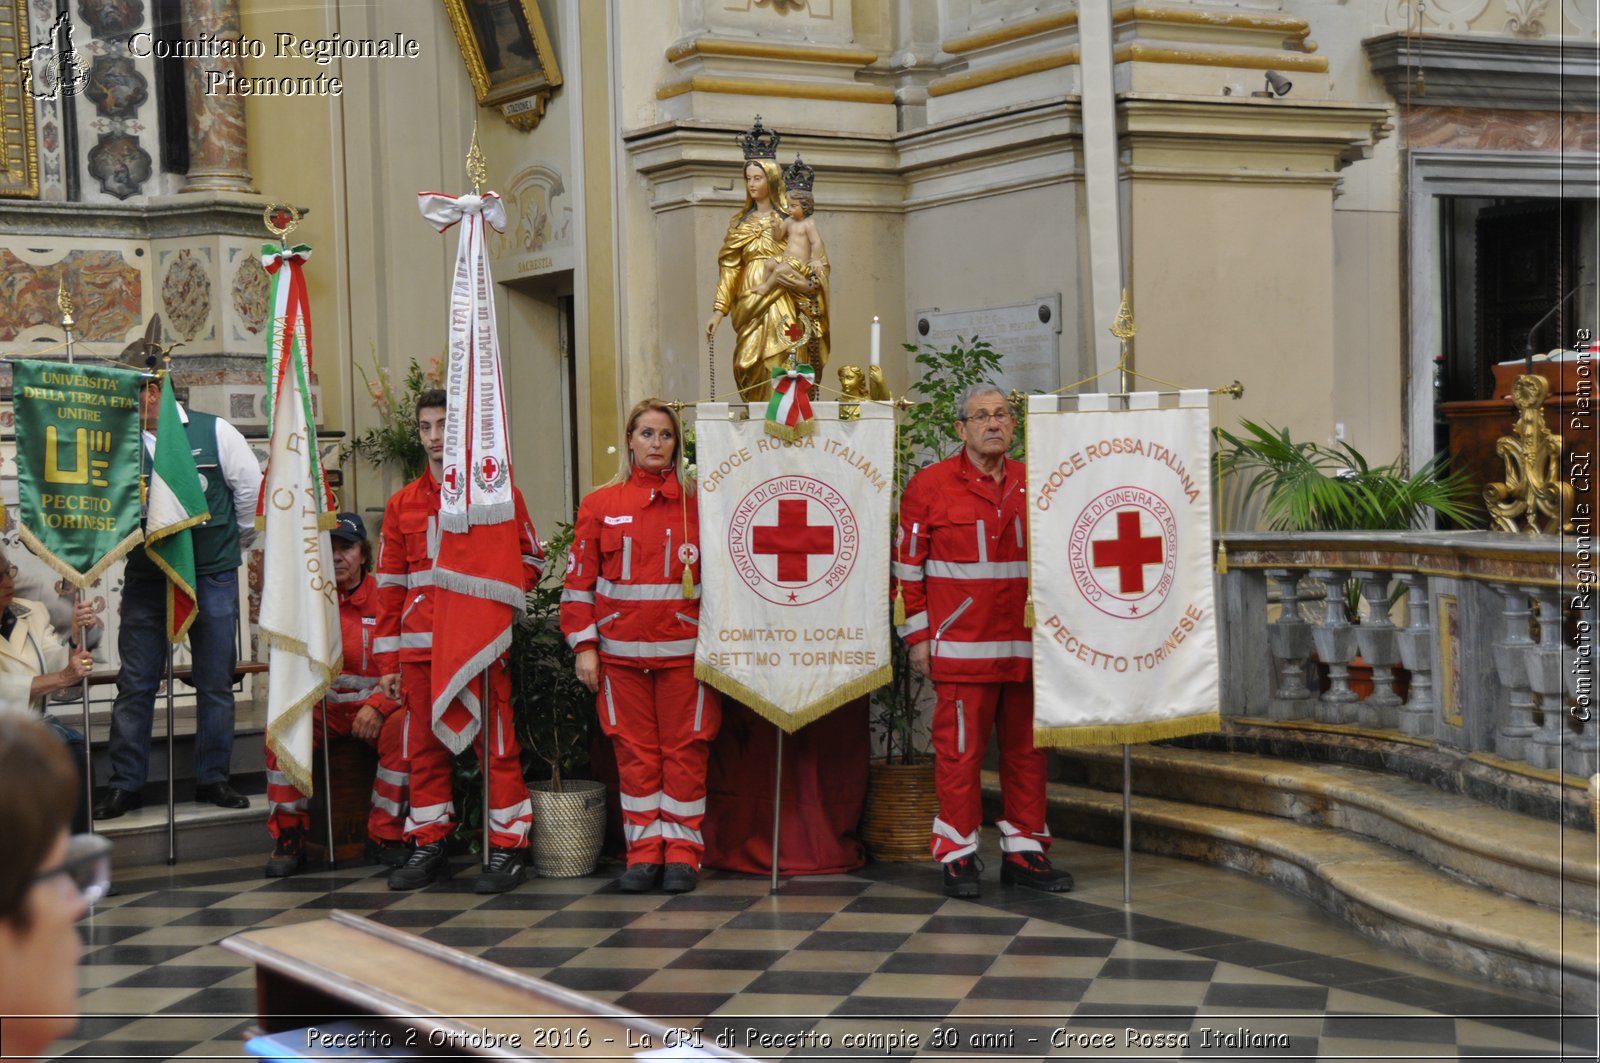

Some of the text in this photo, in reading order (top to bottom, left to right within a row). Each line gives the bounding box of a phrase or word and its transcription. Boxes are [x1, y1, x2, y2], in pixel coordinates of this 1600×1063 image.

[24, 387, 65, 401] DELLA
[69, 391, 106, 406] TERZA
[57, 407, 102, 421] UNITRE
[702, 447, 753, 493] CROCE
[824, 438, 887, 493] ITALIANA
[1036, 437, 1200, 511] CROCE ROSSA ITALIANA
[41, 494, 112, 512] PECETTO
[40, 513, 117, 531] TORINESE
[731, 479, 855, 588] CONVENZIONE DI GINEVRA 22 AGOSTO 1864
[1071, 491, 1176, 602] CONVENZIONE DI GINEVRA 22 AGOSTO 1864
[719, 627, 864, 643] COMITATO LOCALE
[1044, 604, 1204, 673] PECETTO TORINESE
[789, 651, 876, 667] TORINESE
